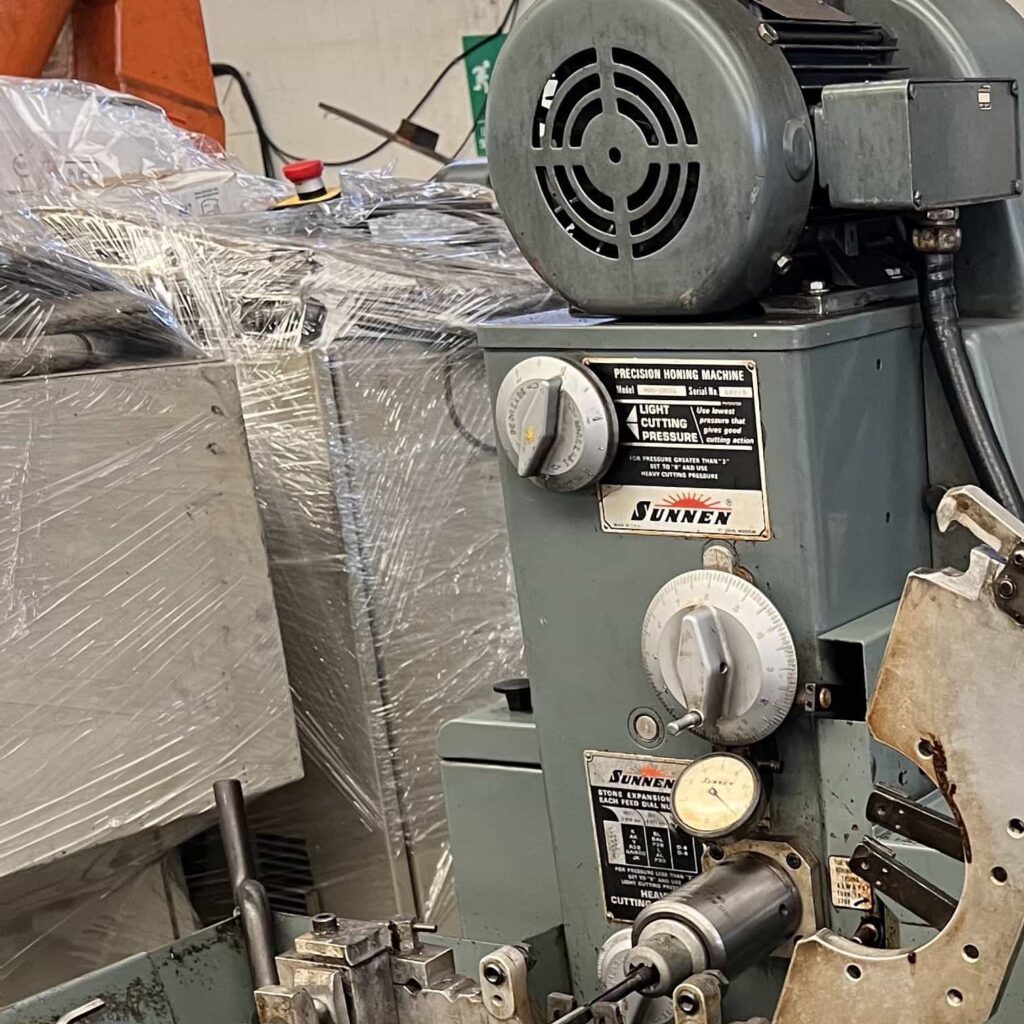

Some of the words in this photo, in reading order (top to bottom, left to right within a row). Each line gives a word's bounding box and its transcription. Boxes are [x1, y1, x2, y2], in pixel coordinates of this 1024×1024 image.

[614, 368, 661, 379] PRECISION
[664, 369, 699, 380] HONING
[701, 370, 745, 382] MACHINE
[616, 385, 635, 394] Model
[688, 386, 707, 396] Serial
[639, 404, 670, 415] LIGHT
[696, 407, 710, 415] Use
[712, 407, 735, 415] lowest
[640, 418, 688, 429] CUTTING
[699, 417, 730, 426] pressure
[703, 427, 722, 435] gives
[723, 427, 742, 435] good
[642, 431, 699, 443] PRESSURE
[706, 436, 731, 445] cutting
[732, 437, 755, 445] action
[661, 471, 687, 479] CUTTING
[688, 472, 719, 480] PRESSURE
[631, 500, 732, 525] SUNNEN
[609, 769, 675, 789] SUNNEN
[598, 789, 622, 798] STONE
[599, 796, 618, 804] EACH
[621, 798, 639, 807] FEED
[641, 801, 659, 809] DIAL
